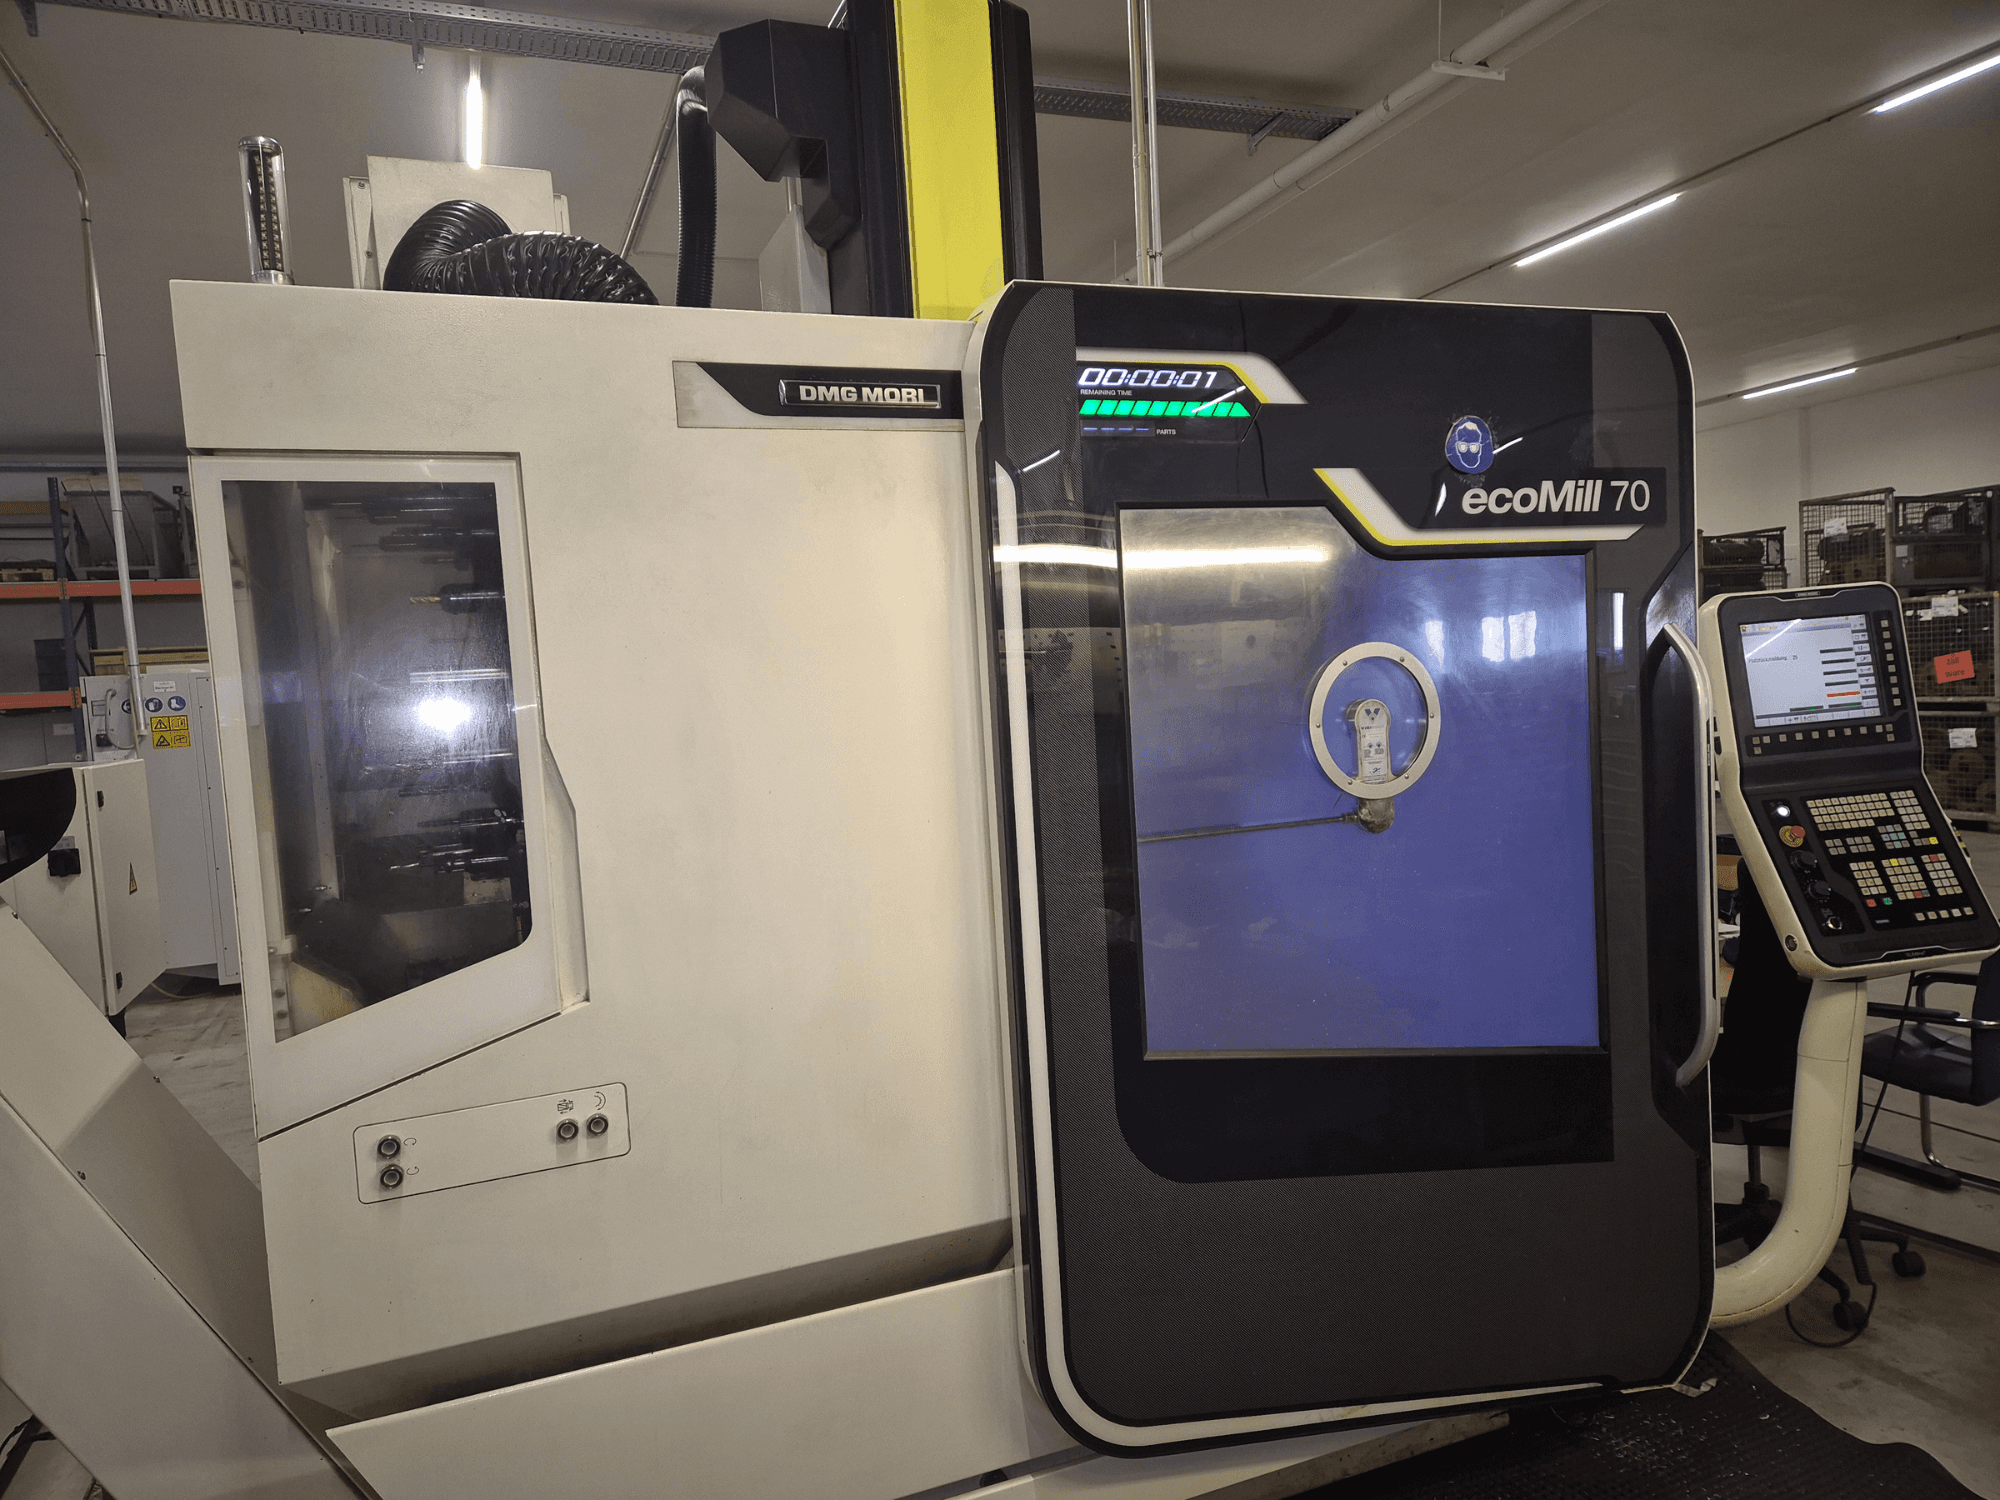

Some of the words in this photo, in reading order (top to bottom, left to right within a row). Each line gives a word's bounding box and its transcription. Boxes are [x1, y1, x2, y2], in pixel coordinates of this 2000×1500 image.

[1078, 367, 1218, 389] 00:00:01
[799, 385, 858, 402] DMG
[861, 386, 925, 404] MORI
[1080, 388, 1116, 396] REMAINING
[1461, 479, 1603, 515] ecoMill
[1610, 479, 1651, 513] 70
